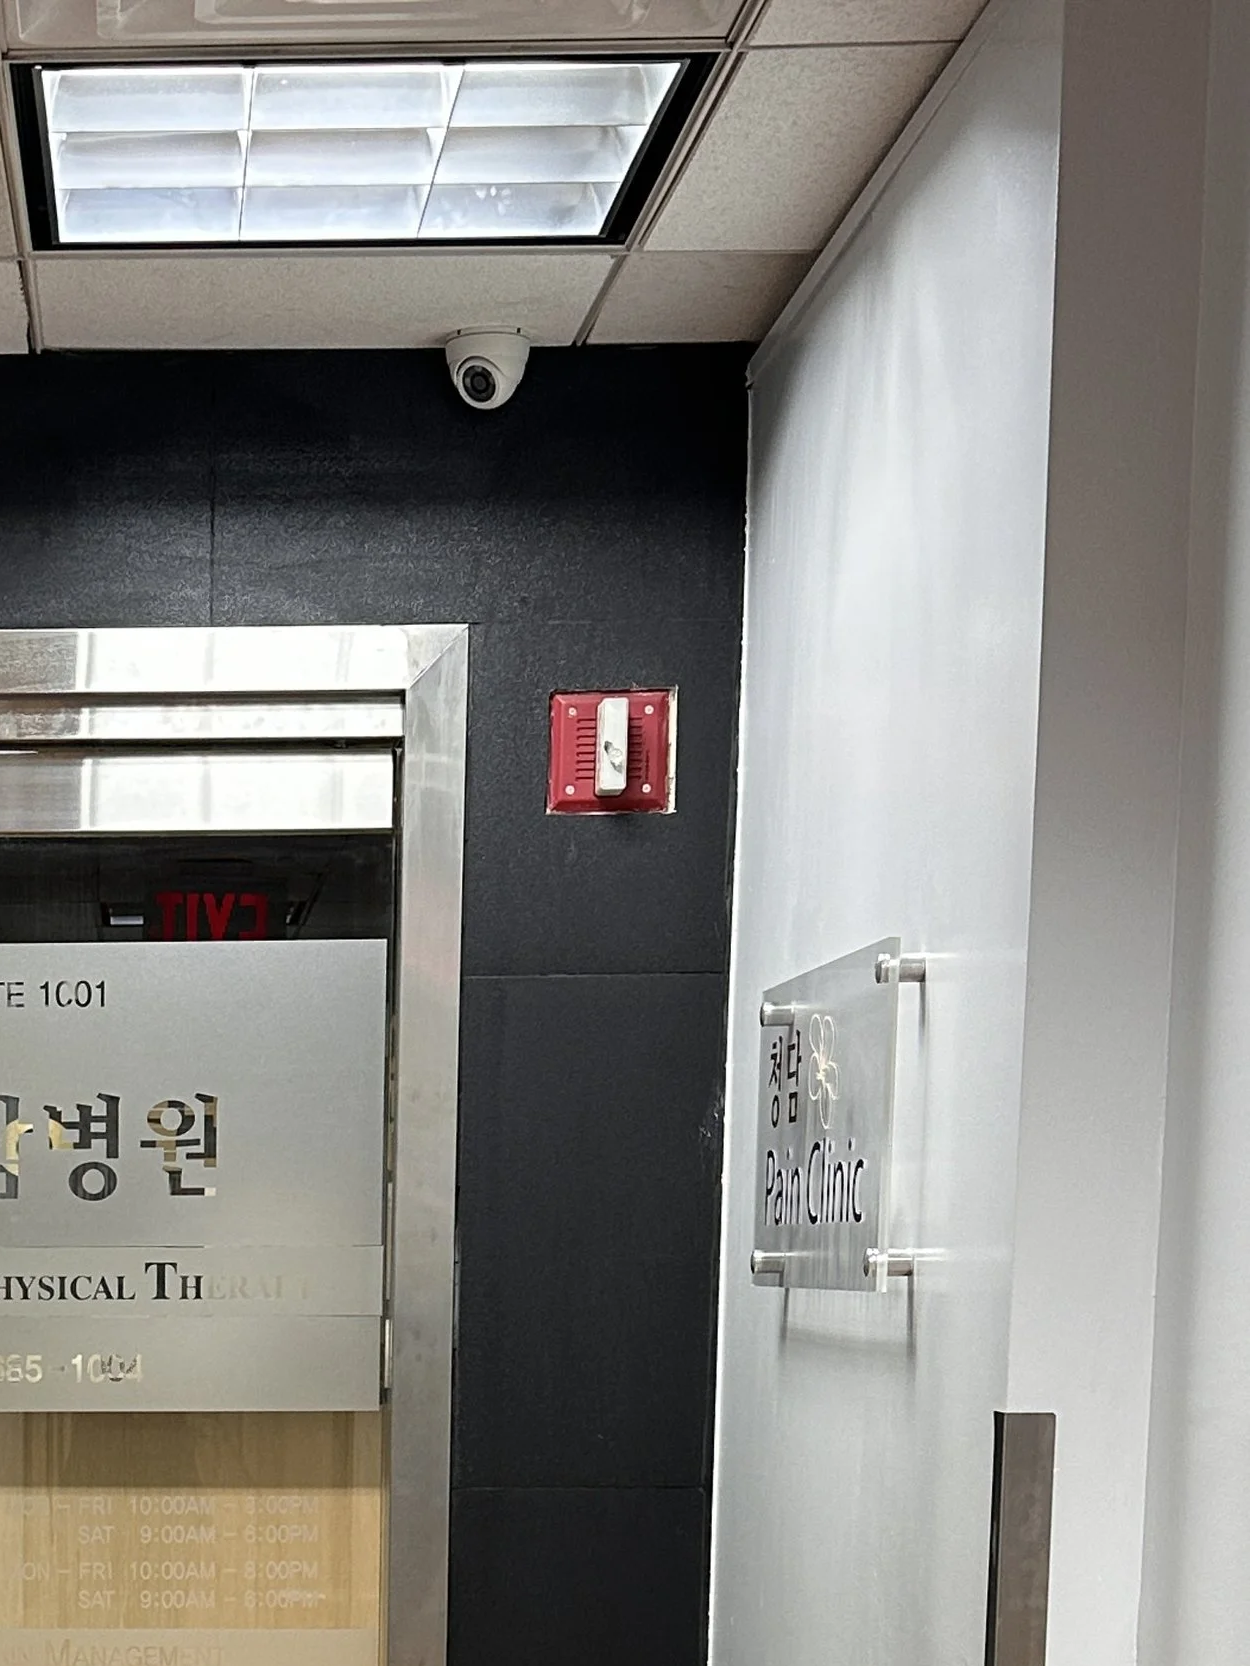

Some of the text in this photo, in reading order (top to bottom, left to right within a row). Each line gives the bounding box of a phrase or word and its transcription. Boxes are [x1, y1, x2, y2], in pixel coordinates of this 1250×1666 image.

[39, 980, 109, 1009] 1001
[768, 1029, 802, 1128] 청담
[764, 1137, 865, 1226] Pain Clinic
[144, 1261, 312, 1303] THERA
[78, 1496, 112, 1515] FRI
[77, 1525, 115, 1544] SAT
[140, 1525, 217, 1544] 9:00AM
[78, 1562, 113, 1580] FRI
[130, 1561, 217, 1581] 10:00AM
[77, 1590, 115, 1609] SAT
[140, 1590, 217, 1609] 9:00AM
